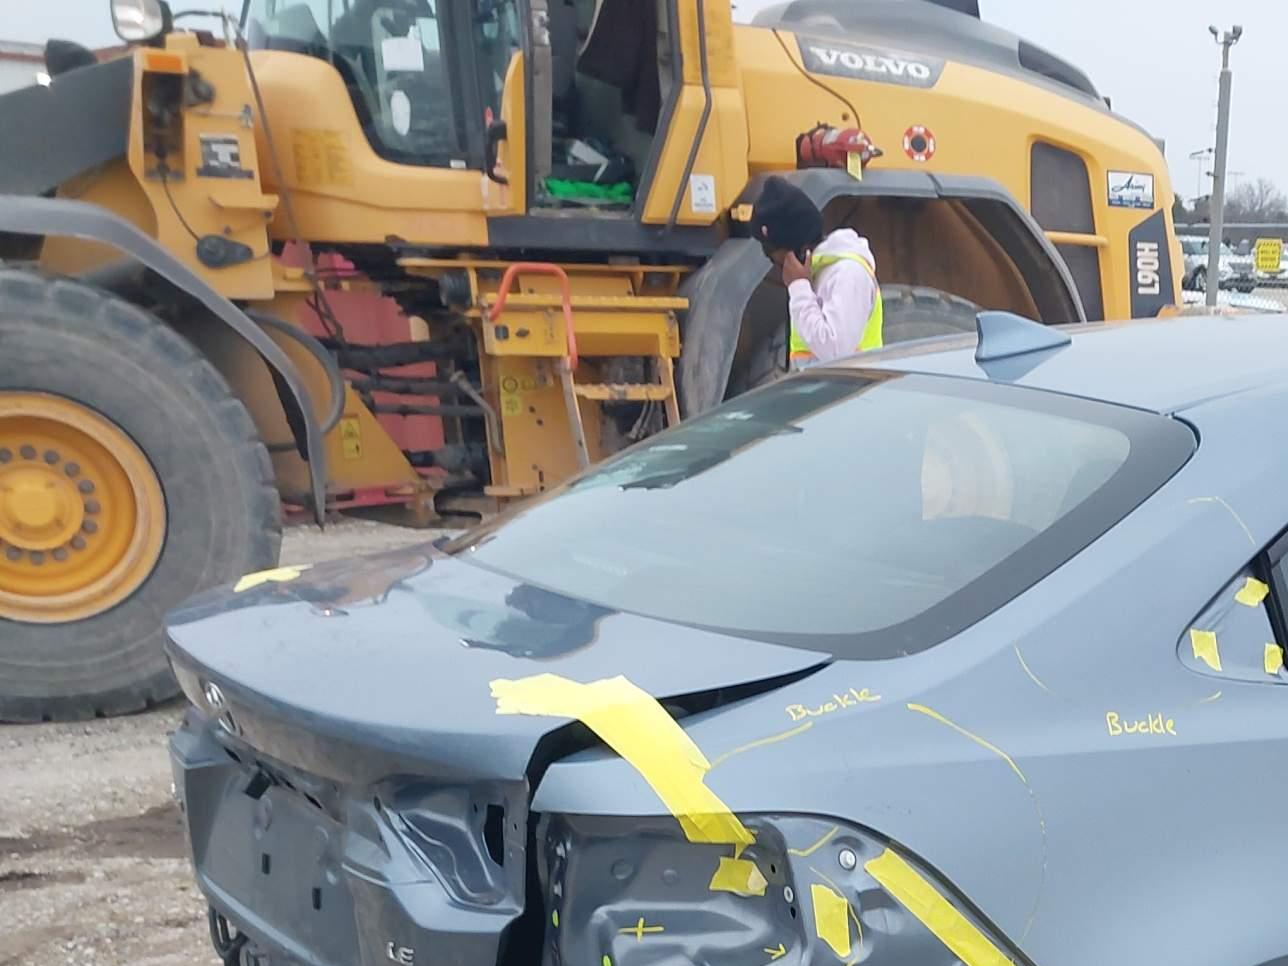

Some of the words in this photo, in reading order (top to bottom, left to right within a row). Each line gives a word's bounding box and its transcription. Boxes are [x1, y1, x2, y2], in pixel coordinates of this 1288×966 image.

[809, 46, 931, 79] VOLVO
[1136, 241, 1160, 296] L90H
[784, 687, 882, 721] Buckle
[1105, 711, 1177, 736] Buckle
[386, 941, 414, 966] LE
